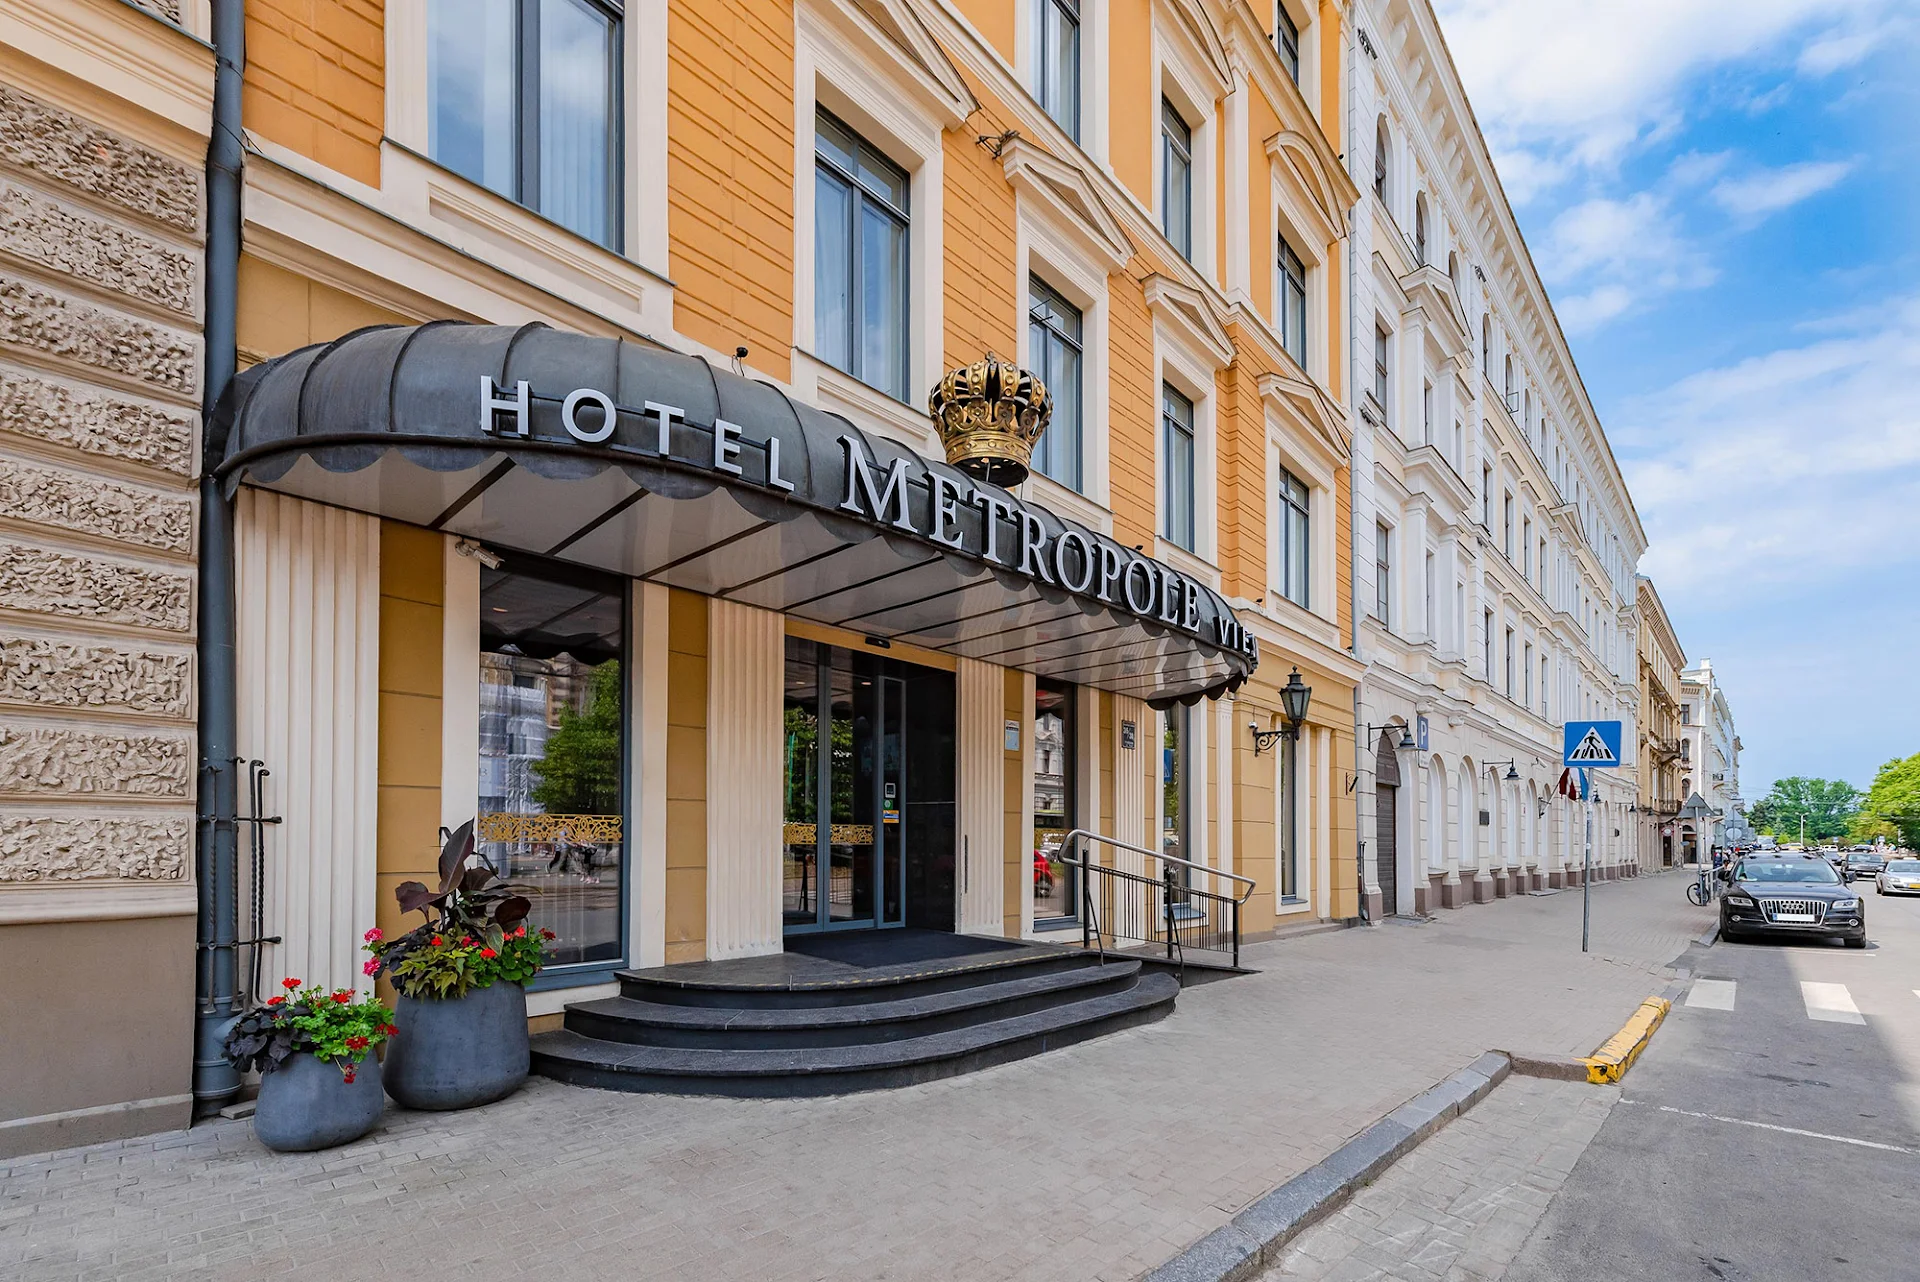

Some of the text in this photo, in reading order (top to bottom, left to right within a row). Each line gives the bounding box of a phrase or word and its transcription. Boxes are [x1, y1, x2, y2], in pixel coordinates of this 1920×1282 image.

[480, 375, 795, 492] HOTEL
[836, 434, 1200, 633] METROPOLE
[1420, 720, 1428, 745] P
